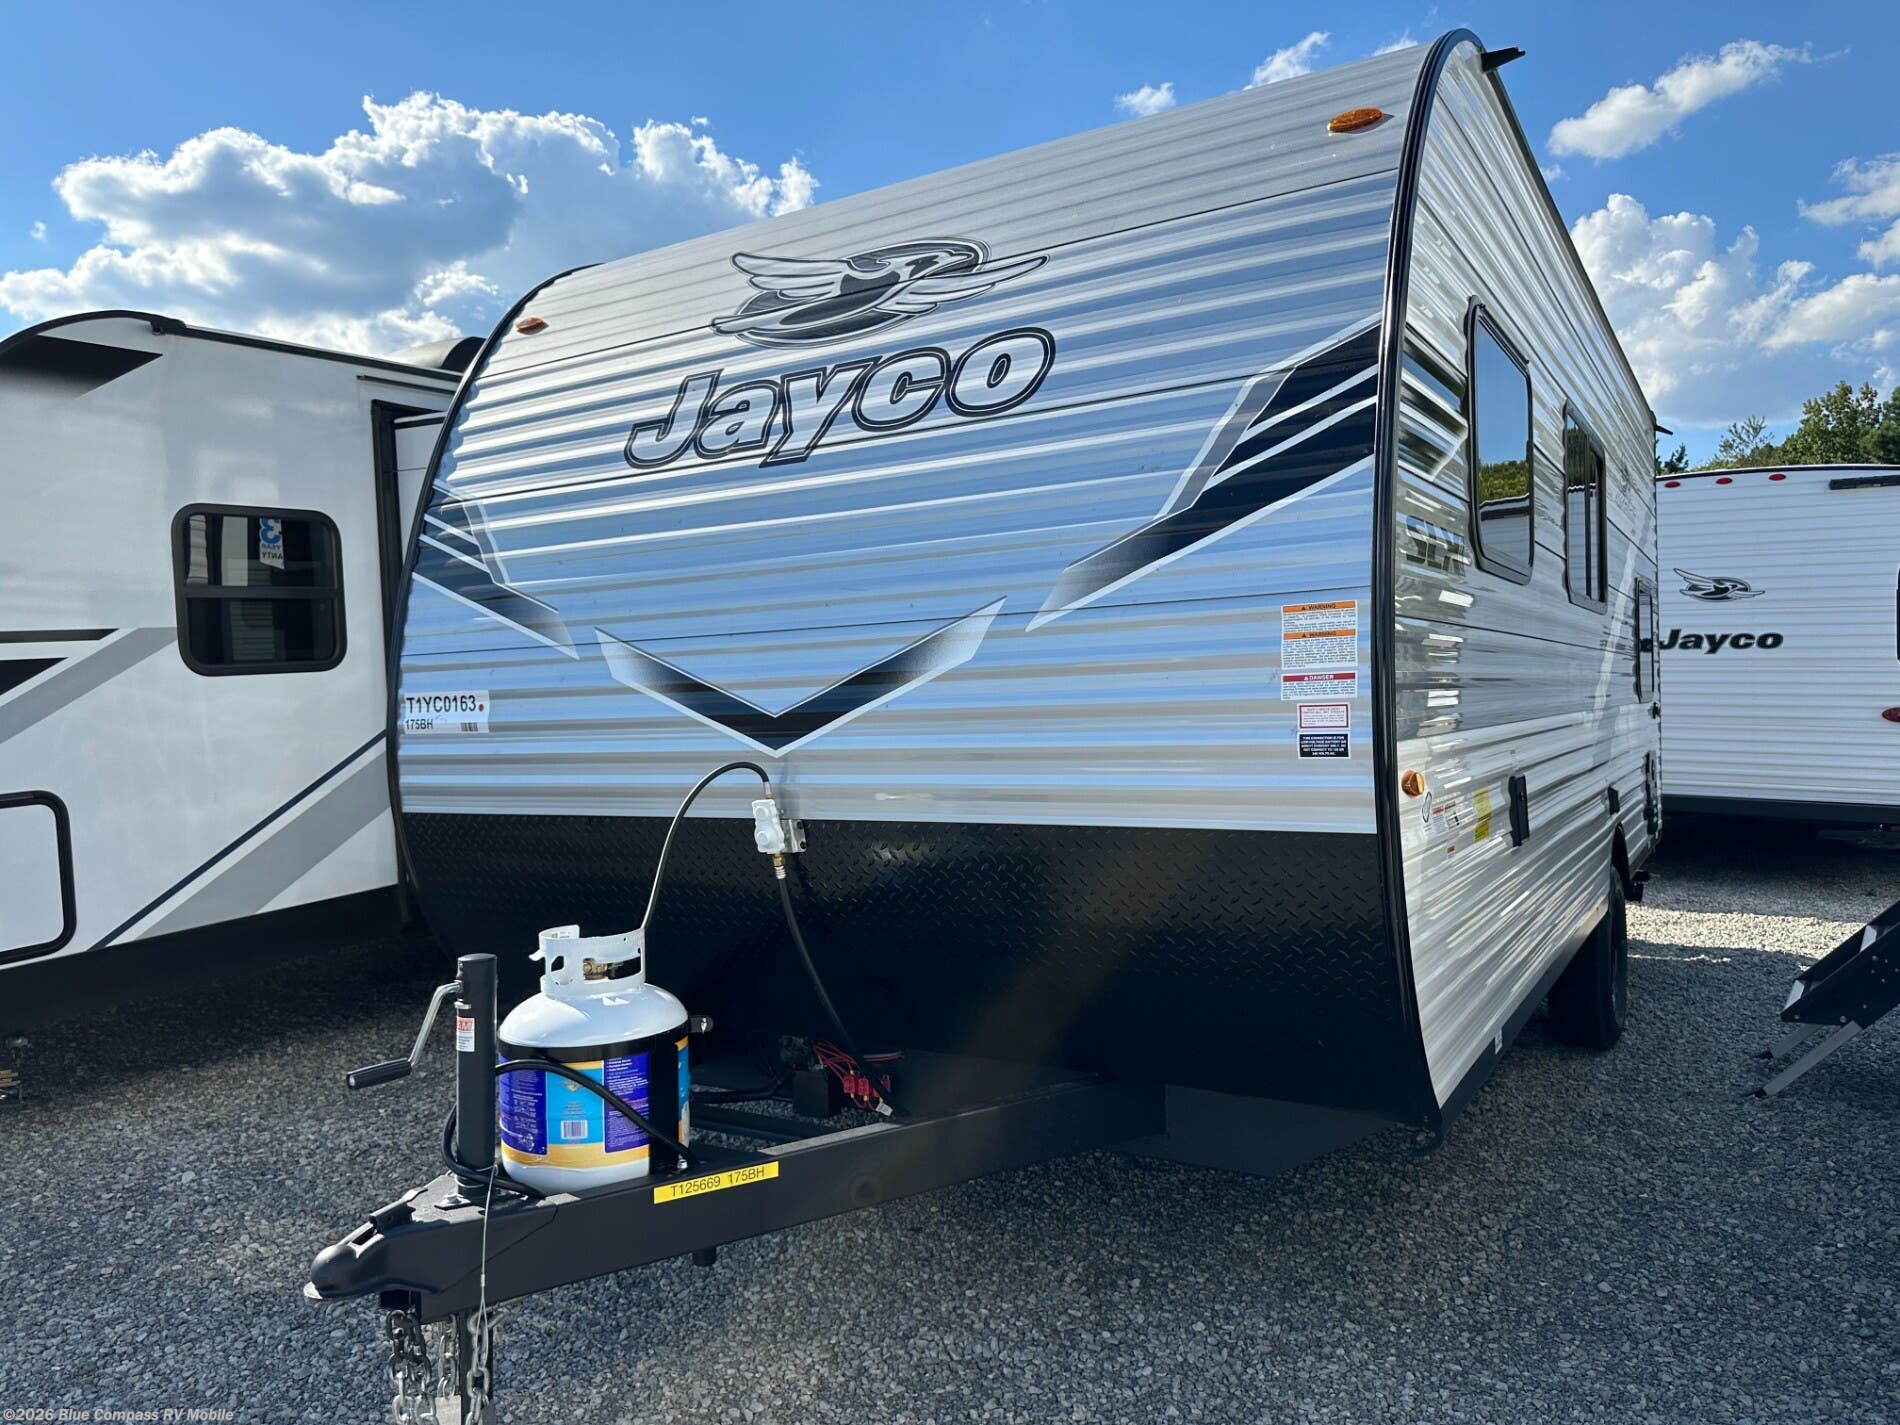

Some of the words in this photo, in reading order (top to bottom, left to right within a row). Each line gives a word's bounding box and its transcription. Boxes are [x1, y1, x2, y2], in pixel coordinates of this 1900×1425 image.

[623, 326, 1056, 469] Jayco
[1659, 629, 1784, 654] Jayco
[406, 695, 476, 713] T1YC0163
[406, 718, 434, 730] 175BH
[670, 1176, 721, 1197] T125669
[728, 1166, 765, 1185] 175BH
